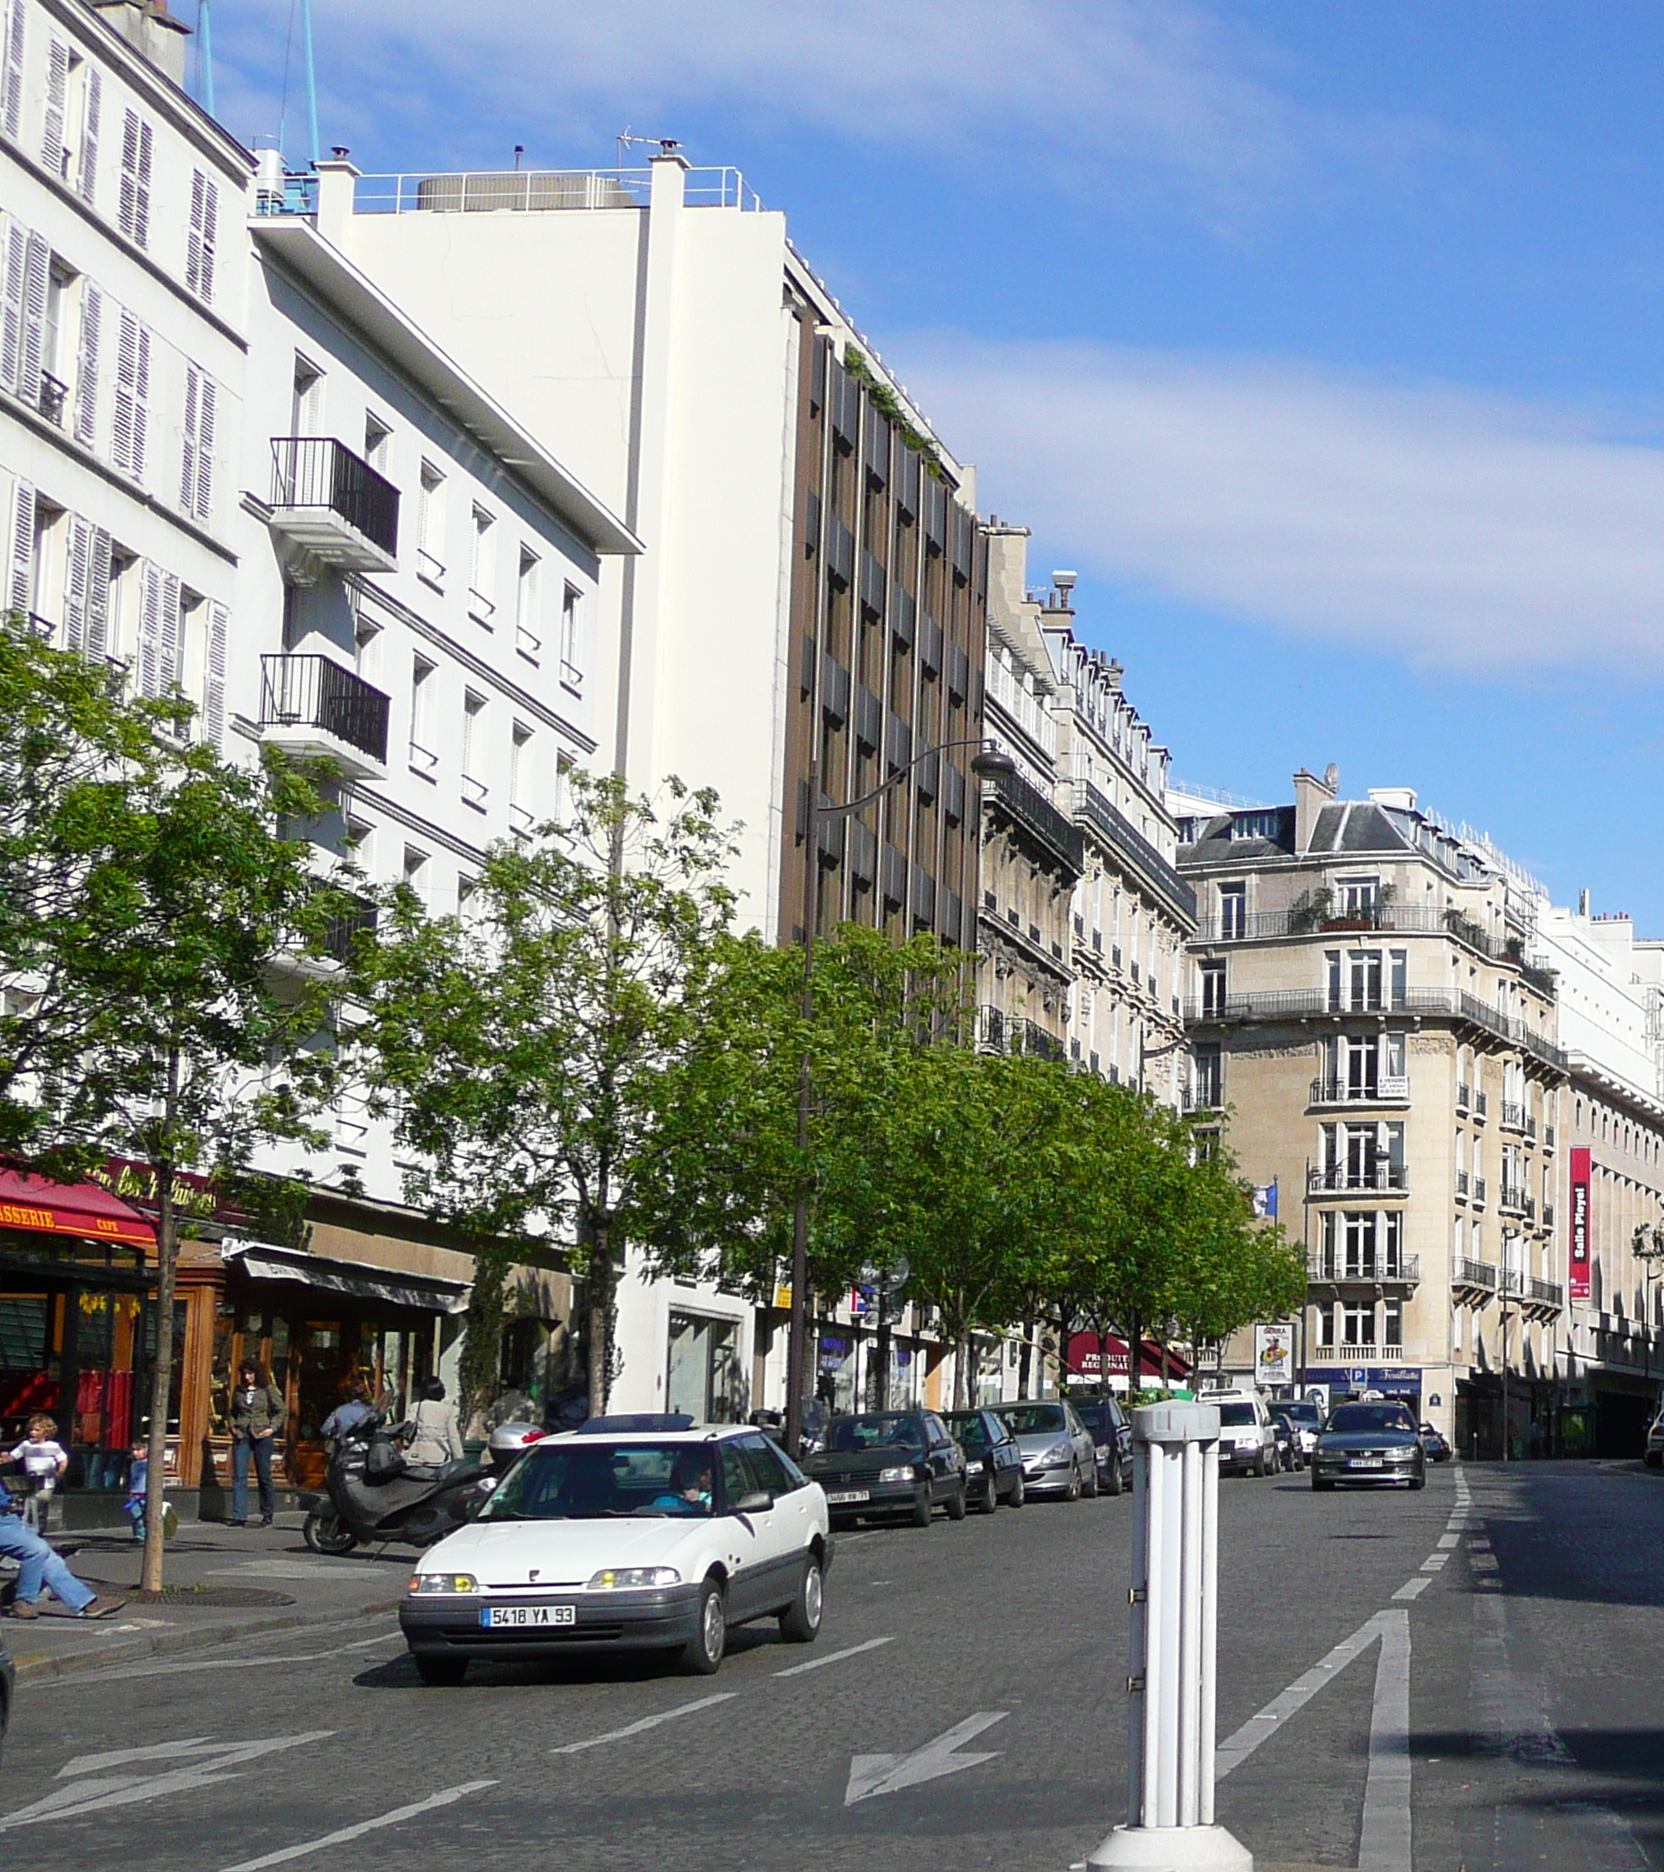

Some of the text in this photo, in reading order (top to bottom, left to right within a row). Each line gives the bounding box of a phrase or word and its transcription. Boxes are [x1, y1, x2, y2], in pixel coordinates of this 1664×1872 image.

[1354, 1370, 1363, 1380] P
[493, 1608, 573, 1624] 5418 YA 93
